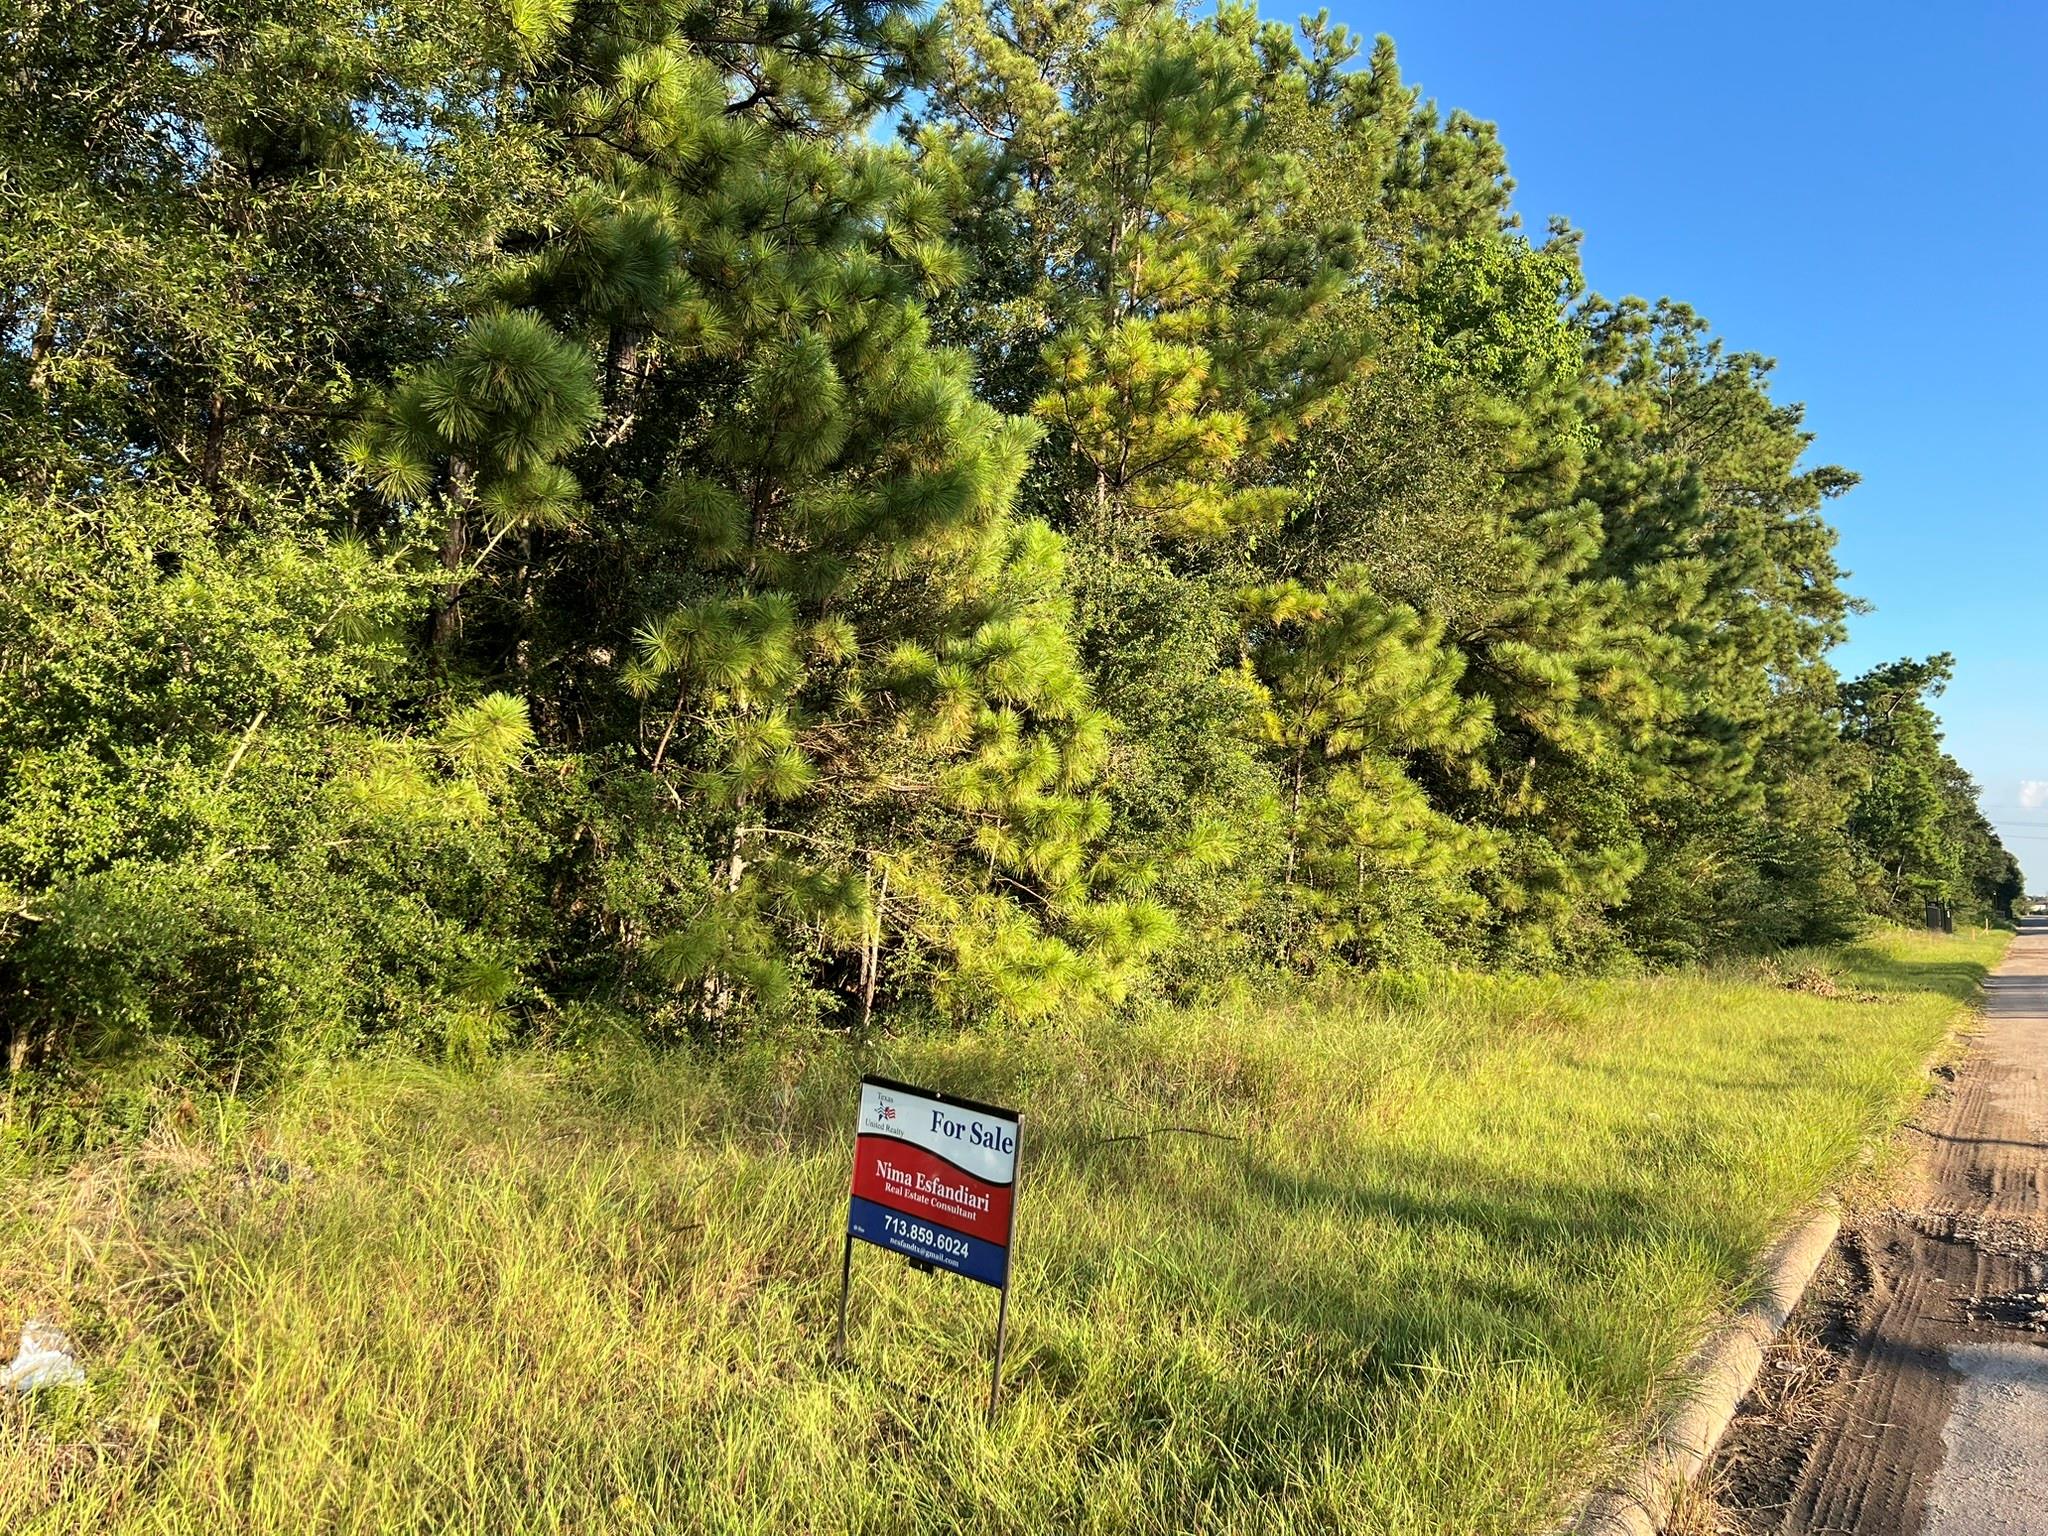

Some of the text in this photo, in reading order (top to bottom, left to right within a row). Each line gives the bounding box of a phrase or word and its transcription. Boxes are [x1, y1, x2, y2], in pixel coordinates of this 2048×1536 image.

[877, 1092, 894, 1103] Texas
[865, 1118, 905, 1138] United Realty
[930, 1110, 1014, 1155] For Sale
[876, 1159, 990, 1212] Nima Esfandiari
[885, 1182, 977, 1221] Real Estate Consultant
[884, 1215, 970, 1259] 713.859.6024
